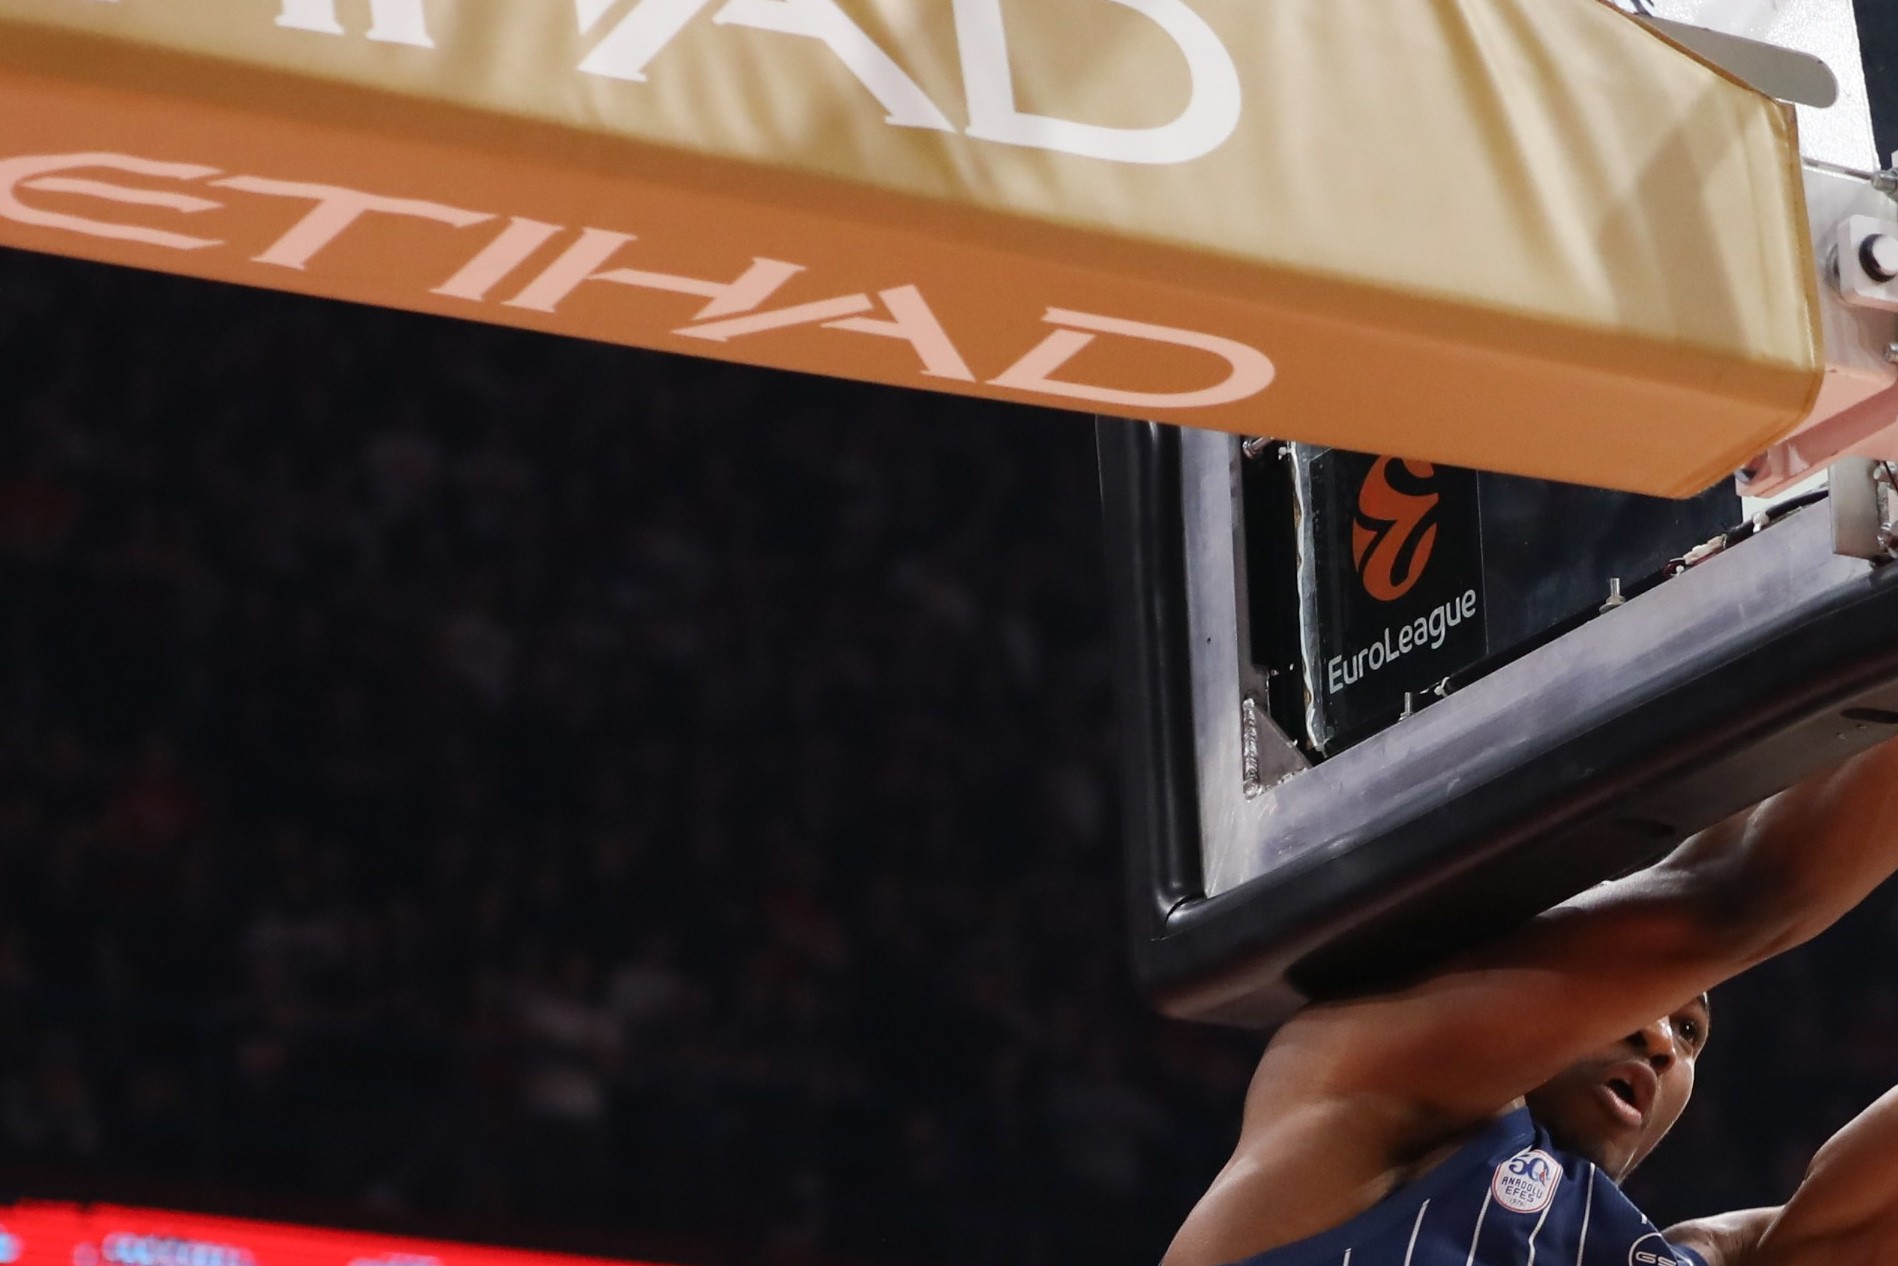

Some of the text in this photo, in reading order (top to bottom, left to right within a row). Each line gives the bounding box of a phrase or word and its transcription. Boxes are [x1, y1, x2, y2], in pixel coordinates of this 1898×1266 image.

[0, 151, 1276, 408] ETIHAD
[1328, 589, 1476, 694] EuroLeague
[1501, 1176, 1543, 1199] ANADOLU
[1505, 1186, 1534, 1203] EFES
